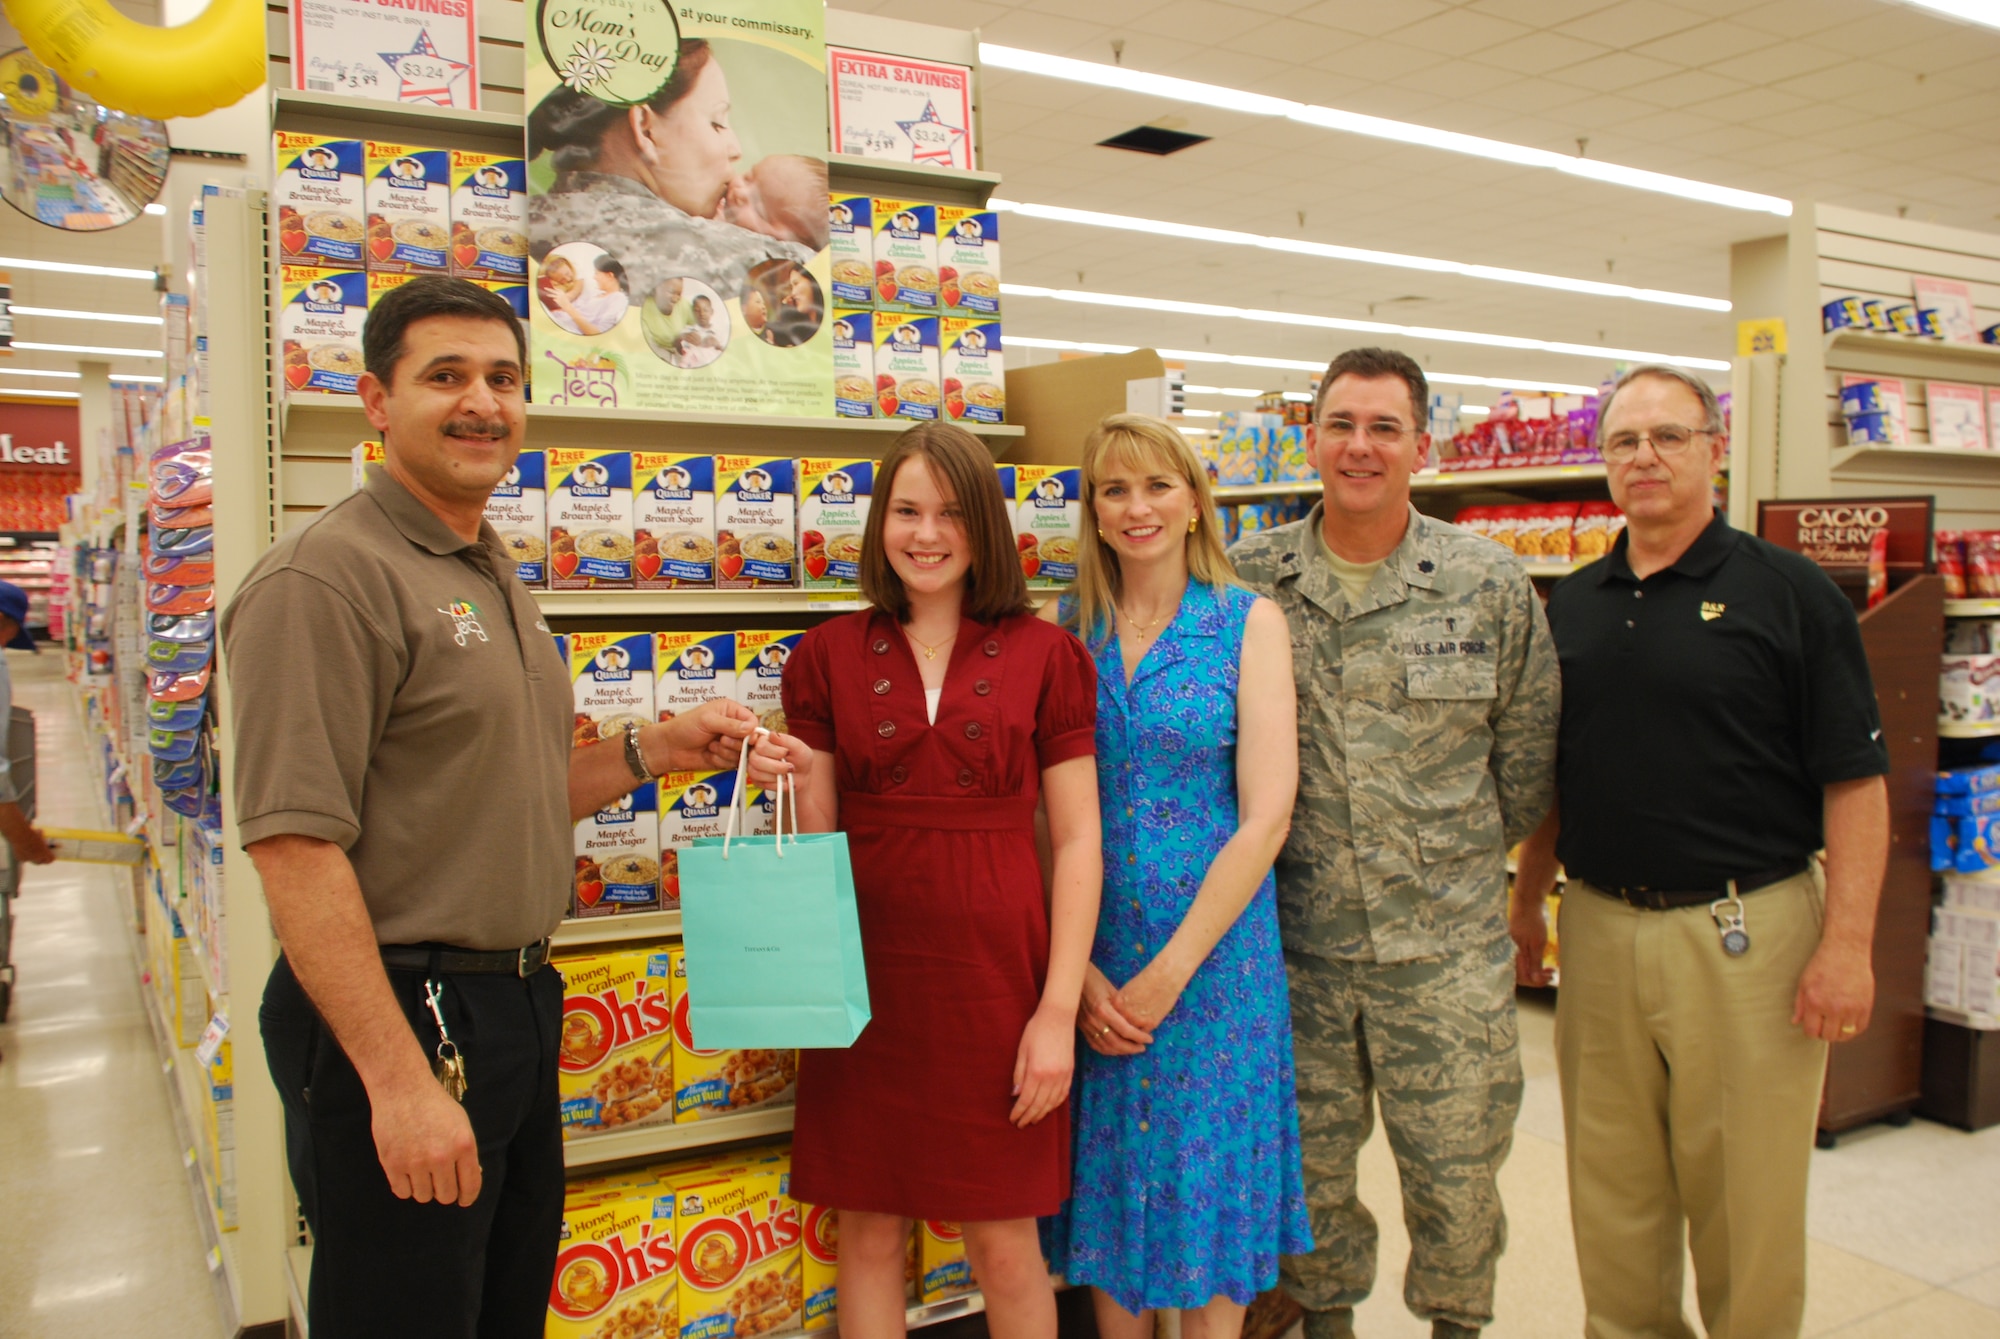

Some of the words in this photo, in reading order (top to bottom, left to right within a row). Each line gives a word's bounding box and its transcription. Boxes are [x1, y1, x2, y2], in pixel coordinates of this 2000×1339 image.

[551, 7, 636, 39] Mom's
[680, 7, 693, 19] at
[697, 12, 727, 26] your
[731, 16, 815, 39] commissary.
[612, 39, 669, 73] Day
[402, 62, 444, 80] $3.24
[838, 59, 889, 79] EXTRA
[893, 68, 963, 90] SAVINGS
[277, 132, 288, 149] 2
[288, 136, 315, 145] FREE
[914, 128, 946, 143] $3.24
[366, 142, 378, 158] 2
[378, 146, 403, 155] FREE
[453, 151, 463, 167] 2
[463, 155, 487, 164] FREE
[282, 265, 293, 282] 2
[293, 269, 319, 279] FREE
[380, 276, 405, 286] FREE
[548, 449, 560, 466] 2
[560, 451, 585, 462] FREE
[633, 453, 645, 470] 2
[644, 455, 669, 466] FREE
[717, 456, 727, 472] 2
[727, 458, 751, 467] FREE
[801, 459, 811, 476] 2
[811, 460, 833, 470] FREE
[1017, 467, 1026, 482] 2
[1026, 469, 1046, 478] FREE
[572, 485, 609, 497] QUAKER
[655, 488, 691, 499] QUAKER
[738, 490, 772, 501] QUAKER
[821, 493, 854, 503] QUAKER
[560, 511, 593, 520] Brown
[595, 511, 622, 523] Sugar
[571, 503, 602, 516] Maple
[654, 506, 685, 518] Maple
[737, 507, 767, 519] Maple
[1798, 506, 1889, 528] CACAO
[644, 514, 675, 523] Brown
[677, 514, 705, 526] Sugar
[727, 515, 757, 525] Brown
[758, 515, 785, 527] Sugar
[1798, 528, 1875, 544] RESERV
[572, 634, 583, 652] 2
[583, 635, 607, 646] FREE
[658, 633, 669, 651] 2
[668, 634, 692, 645] FREE
[737, 632, 747, 649] 2
[747, 633, 770, 643] FREE
[1414, 643, 1435, 656] U.S.
[1437, 642, 1456, 655] AIR
[1460, 641, 1486, 654] FORCE
[594, 669, 630, 680] QUAKER
[679, 668, 715, 680] QUAKER
[593, 687, 625, 698] Maple
[667, 694, 698, 704] Brown
[679, 686, 708, 696] Maple
[747, 691, 776, 701] Brown
[583, 697, 615, 706] Brown
[616, 696, 644, 707] Sugar
[662, 773, 672, 790] 2
[671, 772, 695, 784] FREE
[596, 810, 633, 823] QUAKER
[682, 806, 717, 818] QUAKER
[596, 829, 627, 840] Maple
[681, 823, 711, 834] Maple
[711, 822, 720, 832] &
[585, 839, 617, 849] Brown
[619, 837, 647, 848] Sugar
[570, 965, 611, 986] Honey
[586, 970, 636, 995] Graham
[559, 979, 671, 1073] Oh's
[677, 1095, 702, 1110] GREAT
[702, 1089, 723, 1102] VALUE
[571, 1108, 593, 1121] VALUE
[707, 1186, 746, 1209] Honey
[722, 1190, 769, 1216] Graham
[574, 1210, 616, 1234] Honey
[591, 1215, 641, 1241] Graham
[677, 1199, 801, 1291] Oh's
[548, 1224, 677, 1320] Oh's
[925, 1275, 947, 1290] GREAT
[806, 1300, 829, 1317] GREAT
[707, 1322, 729, 1336] VALUE
